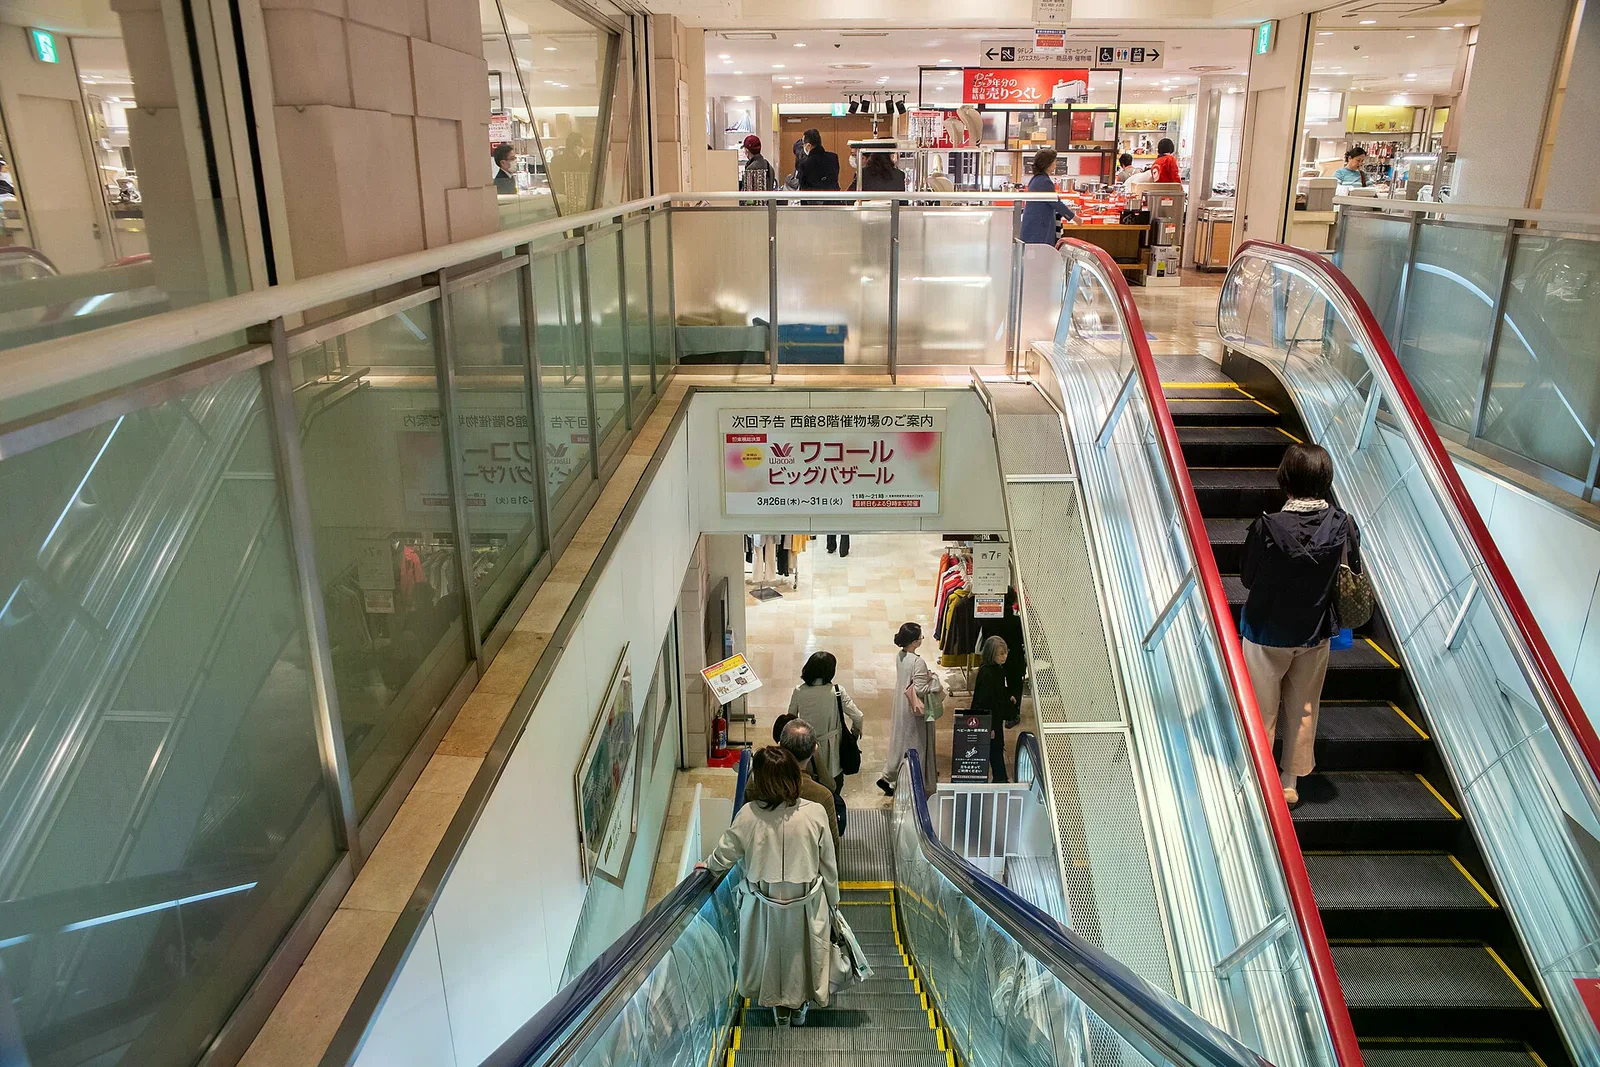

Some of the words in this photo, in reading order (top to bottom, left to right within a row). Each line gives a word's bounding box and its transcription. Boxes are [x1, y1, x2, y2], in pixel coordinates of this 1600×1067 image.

[986, 87, 1042, 100] 売りつくし
[732, 415, 786, 429] 次回予告
[790, 414, 934, 428] 西館8階催物場のご案内
[800, 440, 895, 464] ワコール
[768, 457, 796, 465] Wacoal
[768, 466, 895, 486] ビッグバザール
